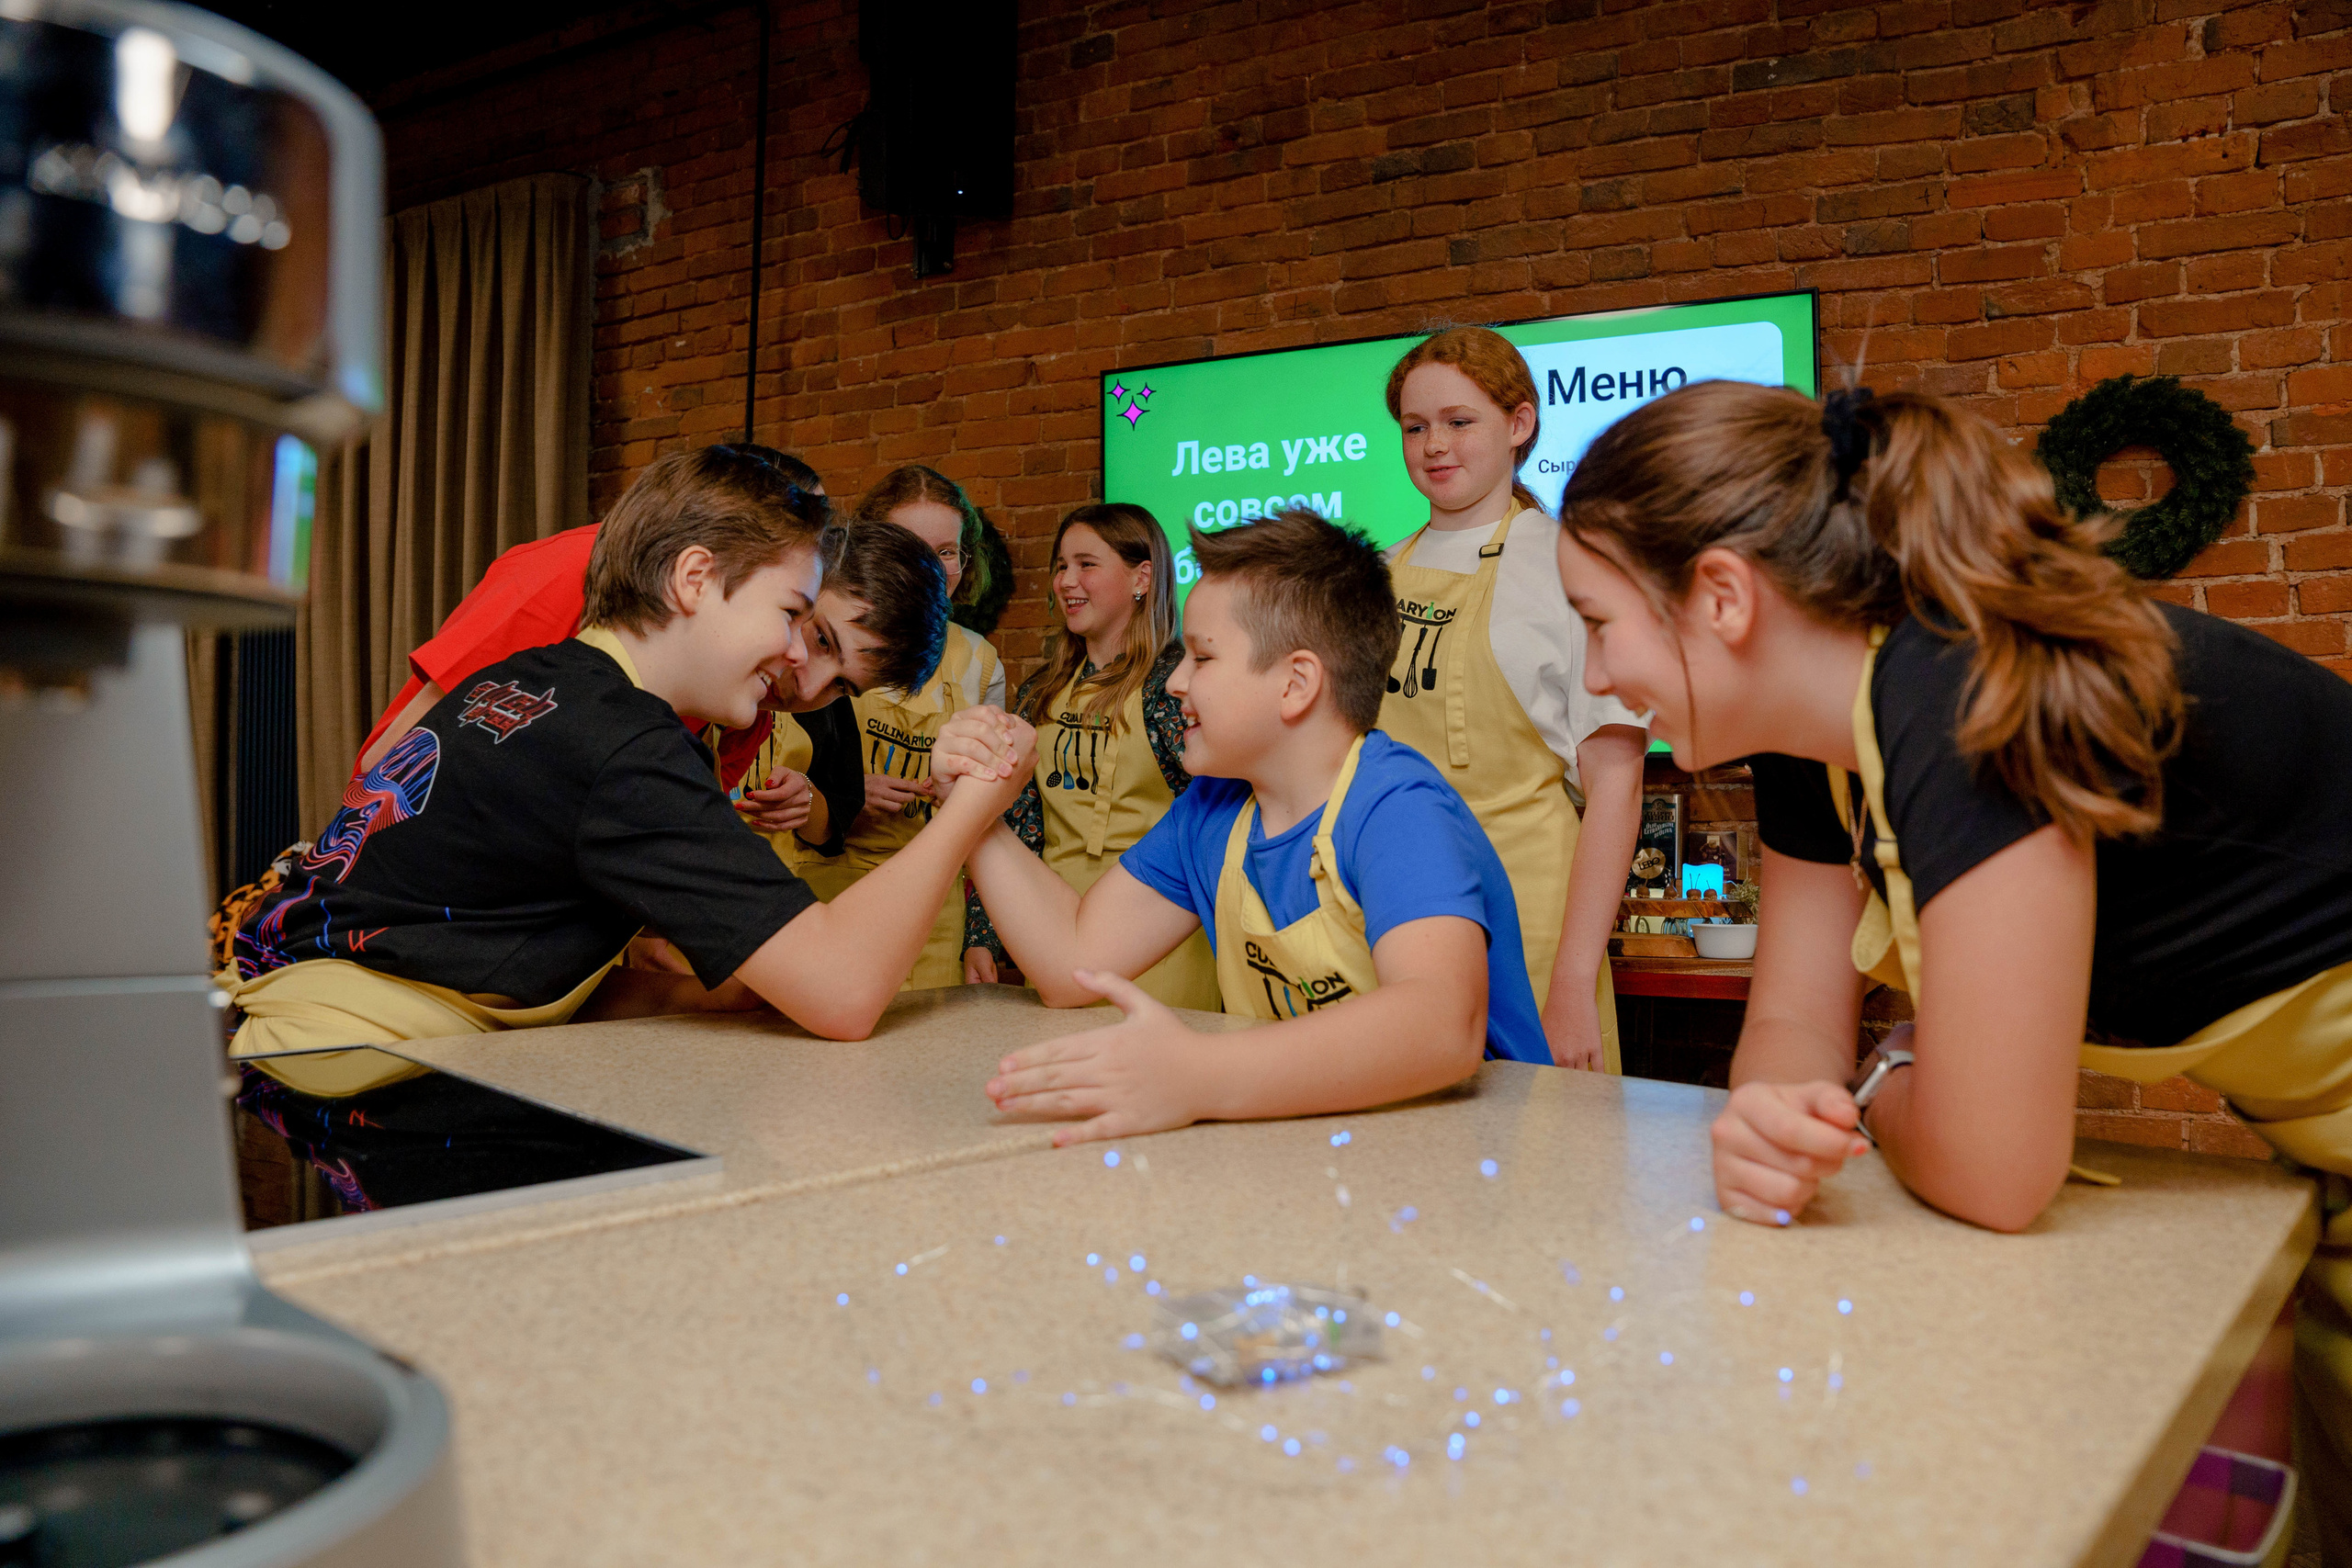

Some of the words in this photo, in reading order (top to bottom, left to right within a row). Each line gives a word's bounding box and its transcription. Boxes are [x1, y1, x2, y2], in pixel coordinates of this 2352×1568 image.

[1548, 367, 1687, 406] Меню
[1171, 440, 1271, 477] Лева
[1281, 433, 1368, 477] уже
[1538, 458, 1578, 476] Сыр
[1638, 857, 1660, 870] LEBO
